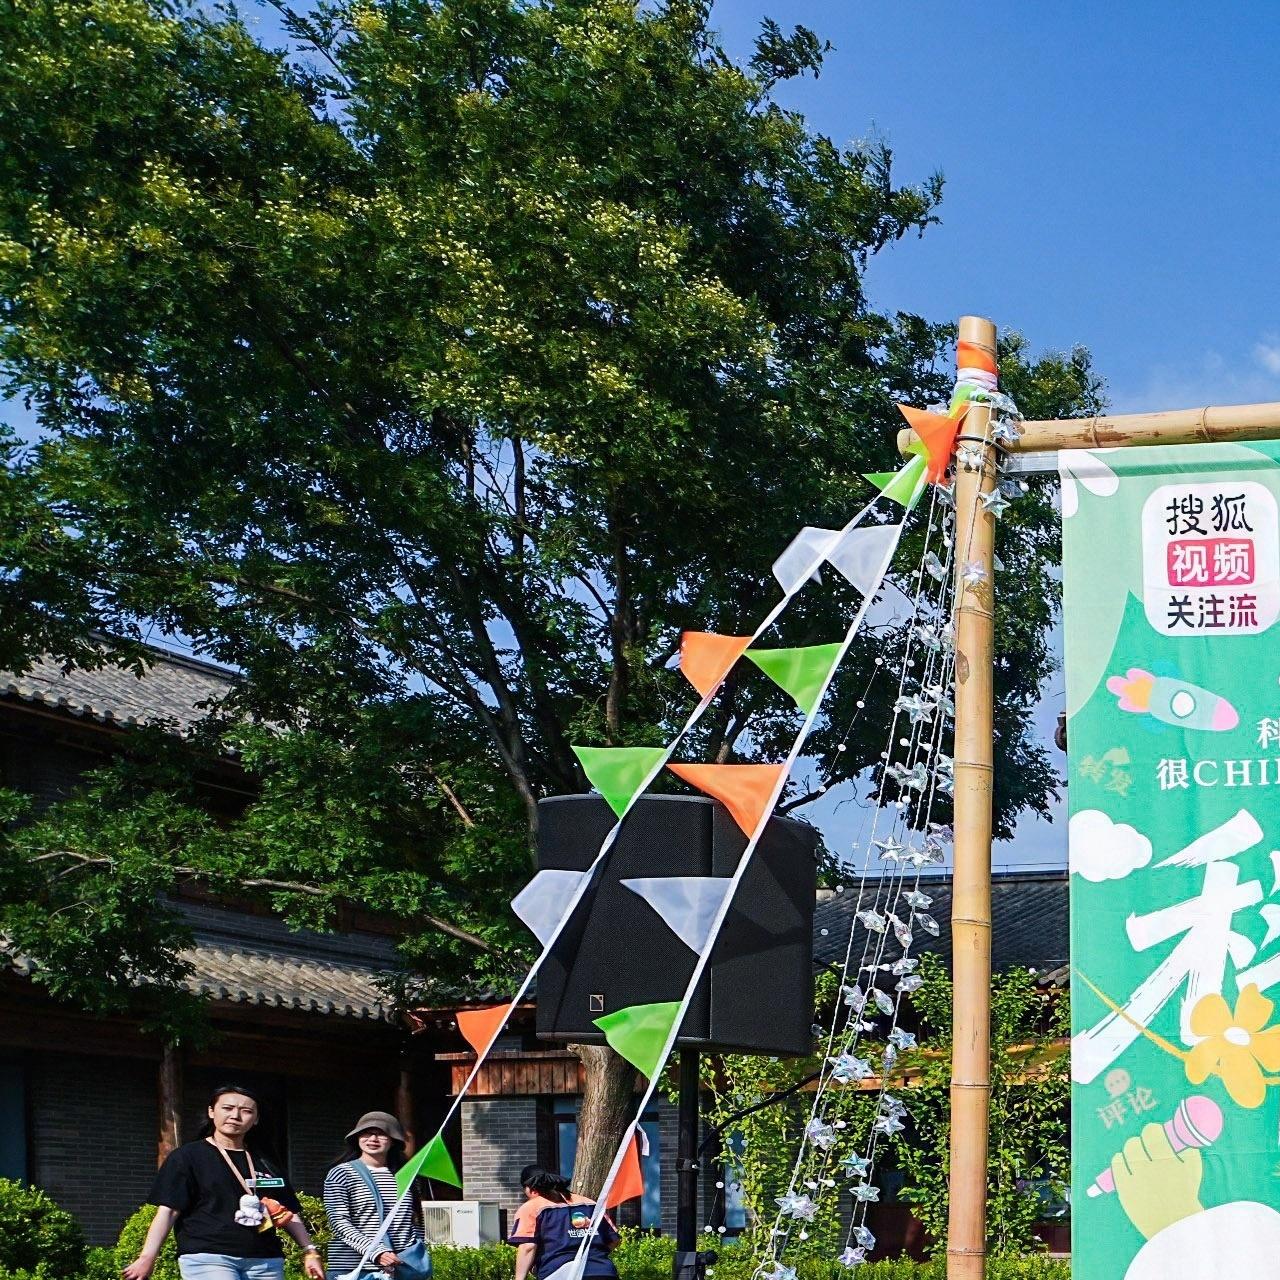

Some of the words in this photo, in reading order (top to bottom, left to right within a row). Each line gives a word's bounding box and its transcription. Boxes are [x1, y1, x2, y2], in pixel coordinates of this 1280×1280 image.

[1166, 493, 1254, 537] 搜狐
[1172, 541, 1252, 585] 视频
[1166, 593, 1258, 630] 关注流
[1096, 1087, 1157, 1130] 评论
